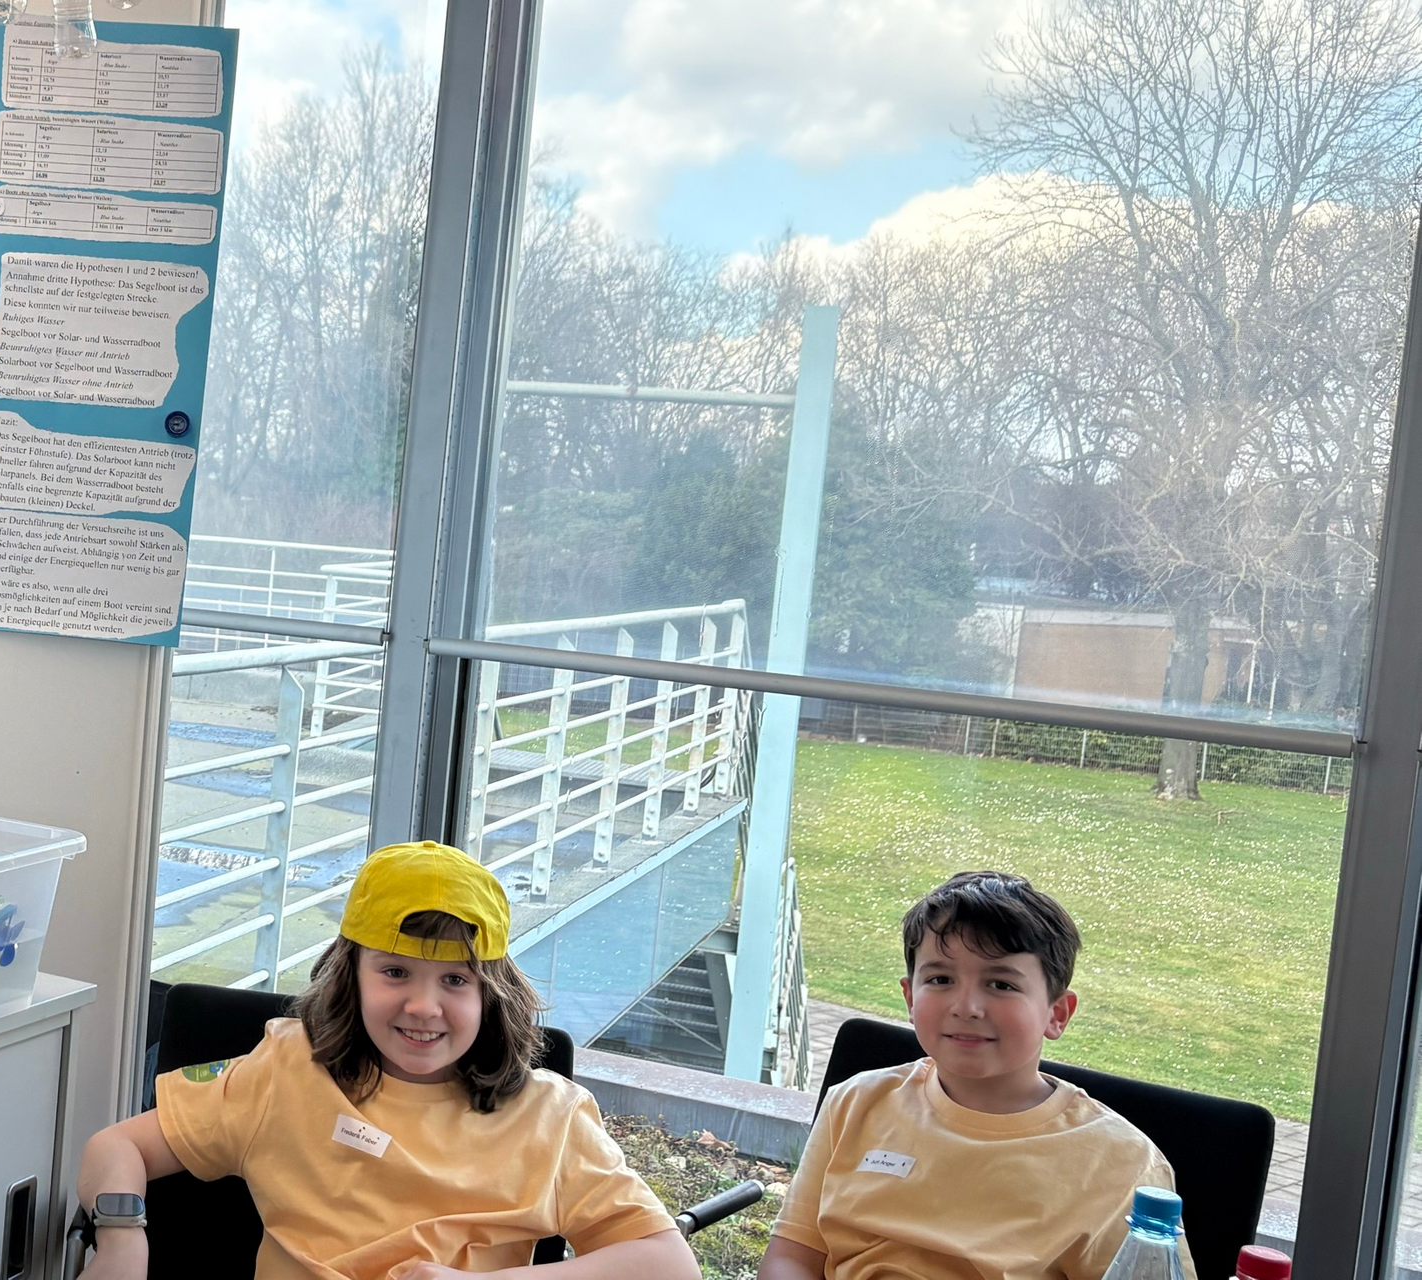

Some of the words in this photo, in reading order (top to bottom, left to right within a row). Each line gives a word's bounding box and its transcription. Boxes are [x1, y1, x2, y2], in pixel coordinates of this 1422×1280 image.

[7, 256, 32, 268] Damit
[60, 260, 74, 270] die
[76, 262, 124, 275] Hypothesen
[127, 266, 130, 274] 1
[133, 267, 149, 275] und
[150, 267, 156, 276] 2
[158, 268, 199, 279] bewiesen!
